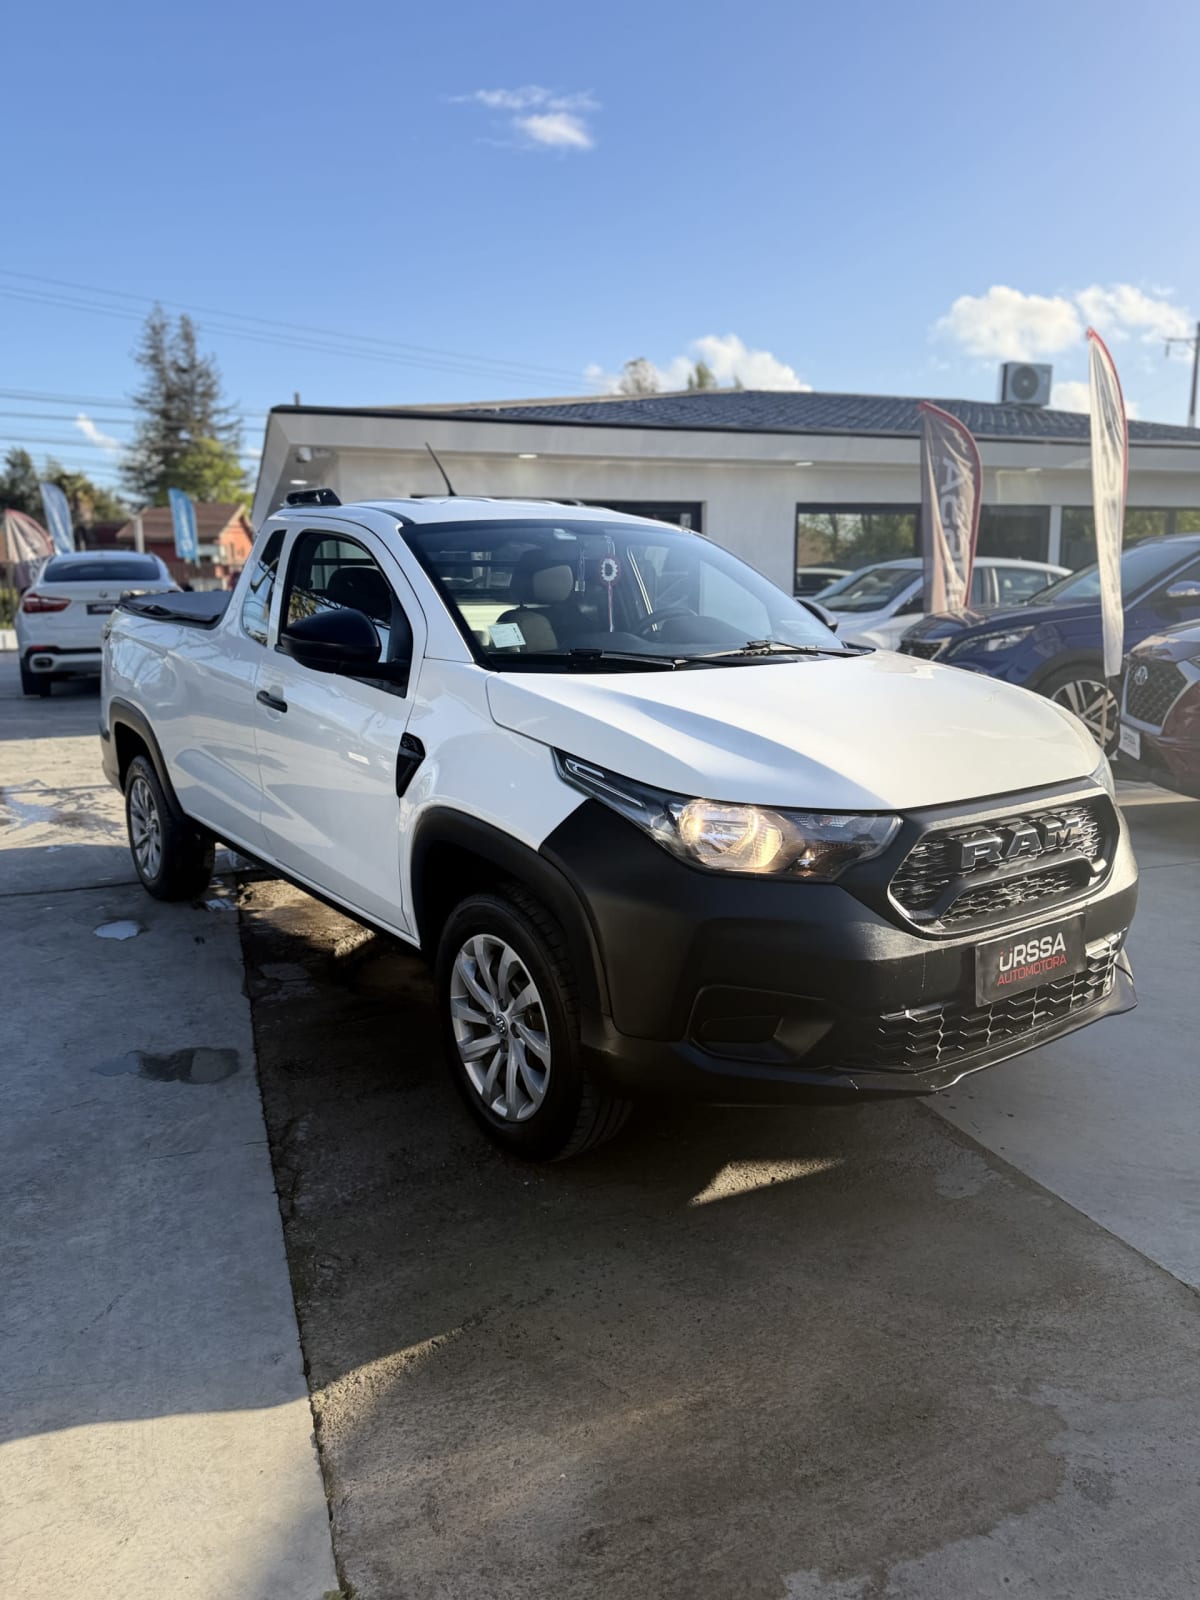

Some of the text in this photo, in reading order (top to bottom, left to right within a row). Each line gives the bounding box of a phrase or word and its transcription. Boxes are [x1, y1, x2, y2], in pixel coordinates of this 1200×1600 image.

[961, 815, 1081, 868] RAM
[997, 954, 1067, 986] AUTOMOTORA
[999, 932, 1066, 972] ÜRSSA
